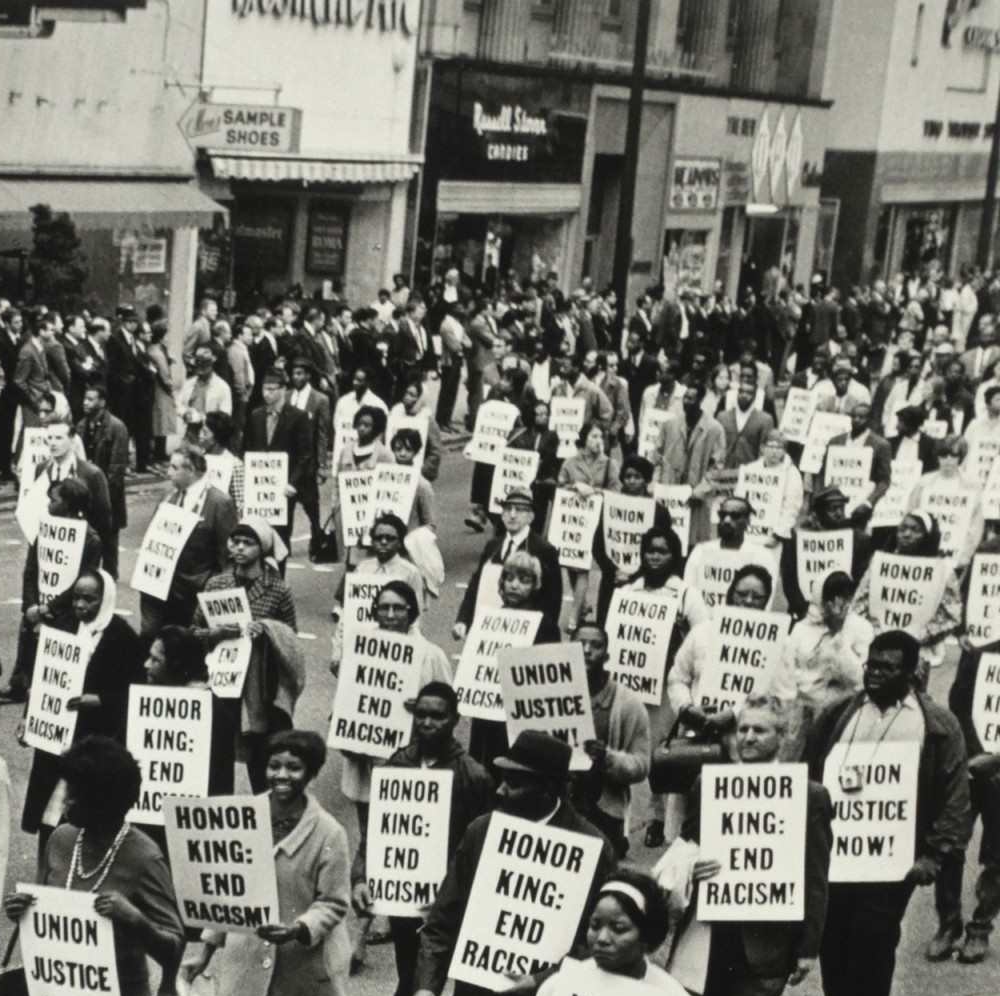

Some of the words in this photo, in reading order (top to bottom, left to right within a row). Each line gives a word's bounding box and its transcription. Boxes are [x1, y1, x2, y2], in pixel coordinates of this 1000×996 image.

[223, 109, 286, 127] SAMPLE
[226, 130, 280, 147] SHOES
[250, 459, 283, 470] HONOR
[502, 452, 532, 467] HONOR
[377, 470, 412, 484] HONOR
[744, 473, 778, 486] HONOR
[257, 491, 277, 503] END
[560, 497, 594, 511] HONOR
[928, 494, 968, 506] HONOR
[608, 505, 645, 524] UNION
[562, 532, 582, 546] END
[802, 537, 845, 553] HONOR
[611, 549, 638, 565] NOW!
[879, 560, 934, 581] HONOR
[206, 596, 245, 617] HONOR
[879, 586, 925, 606] KING:
[617, 598, 668, 622] HONOR
[885, 608, 913, 628] END
[481, 614, 531, 637] HONOR
[617, 623, 657, 647] KING:
[720, 617, 779, 643] HONOR
[42, 636, 81, 665] HONOR
[218, 646, 239, 664] END
[354, 634, 414, 665] HONOR
[619, 647, 648, 669] END
[720, 643, 766, 669] KING:
[41, 665, 73, 692] KING:
[355, 664, 404, 693] KING:
[510, 660, 574, 688] UNION
[720, 671, 755, 695] END
[41, 693, 62, 716] END
[139, 696, 202, 721] HONOR
[357, 694, 392, 719] END
[511, 695, 586, 720] JUSTICE
[28, 715, 69, 747] RACISM!
[143, 728, 194, 754] KING:
[336, 718, 404, 749] RACISM!
[149, 760, 184, 784] END
[378, 778, 440, 804] HONOR
[714, 775, 794, 800] HONOR
[174, 805, 257, 831] HONOR
[380, 811, 431, 839] KING:
[721, 811, 785, 836] KING:
[187, 839, 254, 865] KING:
[383, 845, 420, 870] END
[497, 828, 585, 874] HONOR
[836, 835, 895, 857] NOW!
[729, 847, 774, 871] END
[199, 872, 246, 898] END
[369, 878, 439, 905] RACISM!
[494, 868, 565, 911] KING:
[706, 881, 796, 906] RACISM!
[183, 899, 271, 928] RACISM!
[32, 912, 99, 947] UNION
[494, 910, 546, 946] END
[30, 956, 112, 993] JUSTICE
